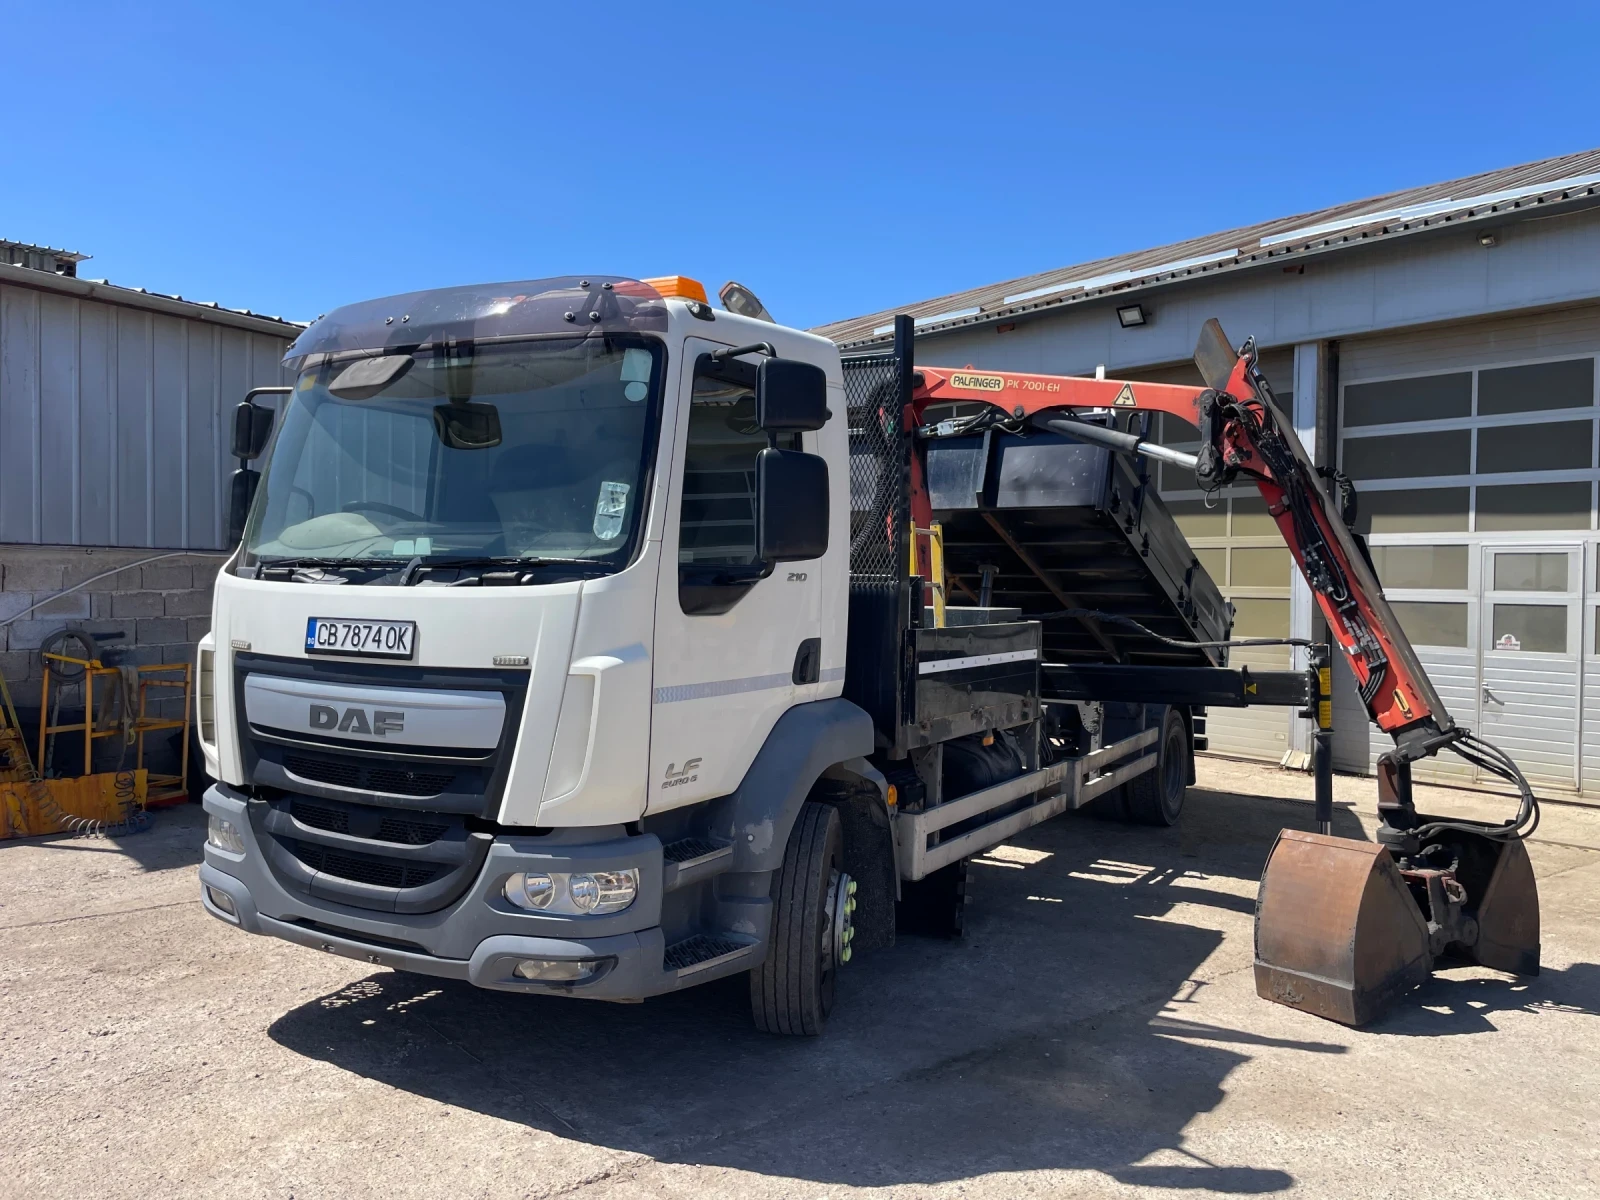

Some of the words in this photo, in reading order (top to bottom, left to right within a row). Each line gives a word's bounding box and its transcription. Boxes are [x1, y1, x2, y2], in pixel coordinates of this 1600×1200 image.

[953, 375, 1001, 389] PALFINGER
[1006, 379, 1020, 389] PK
[786, 572, 808, 581] 210
[307, 637, 315, 645] BG
[317, 623, 338, 646] CB
[340, 624, 382, 649] 7874
[385, 626, 409, 651] OK
[309, 704, 405, 736] DAF
[664, 757, 703, 780] LF
[661, 776, 690, 790] EURO
